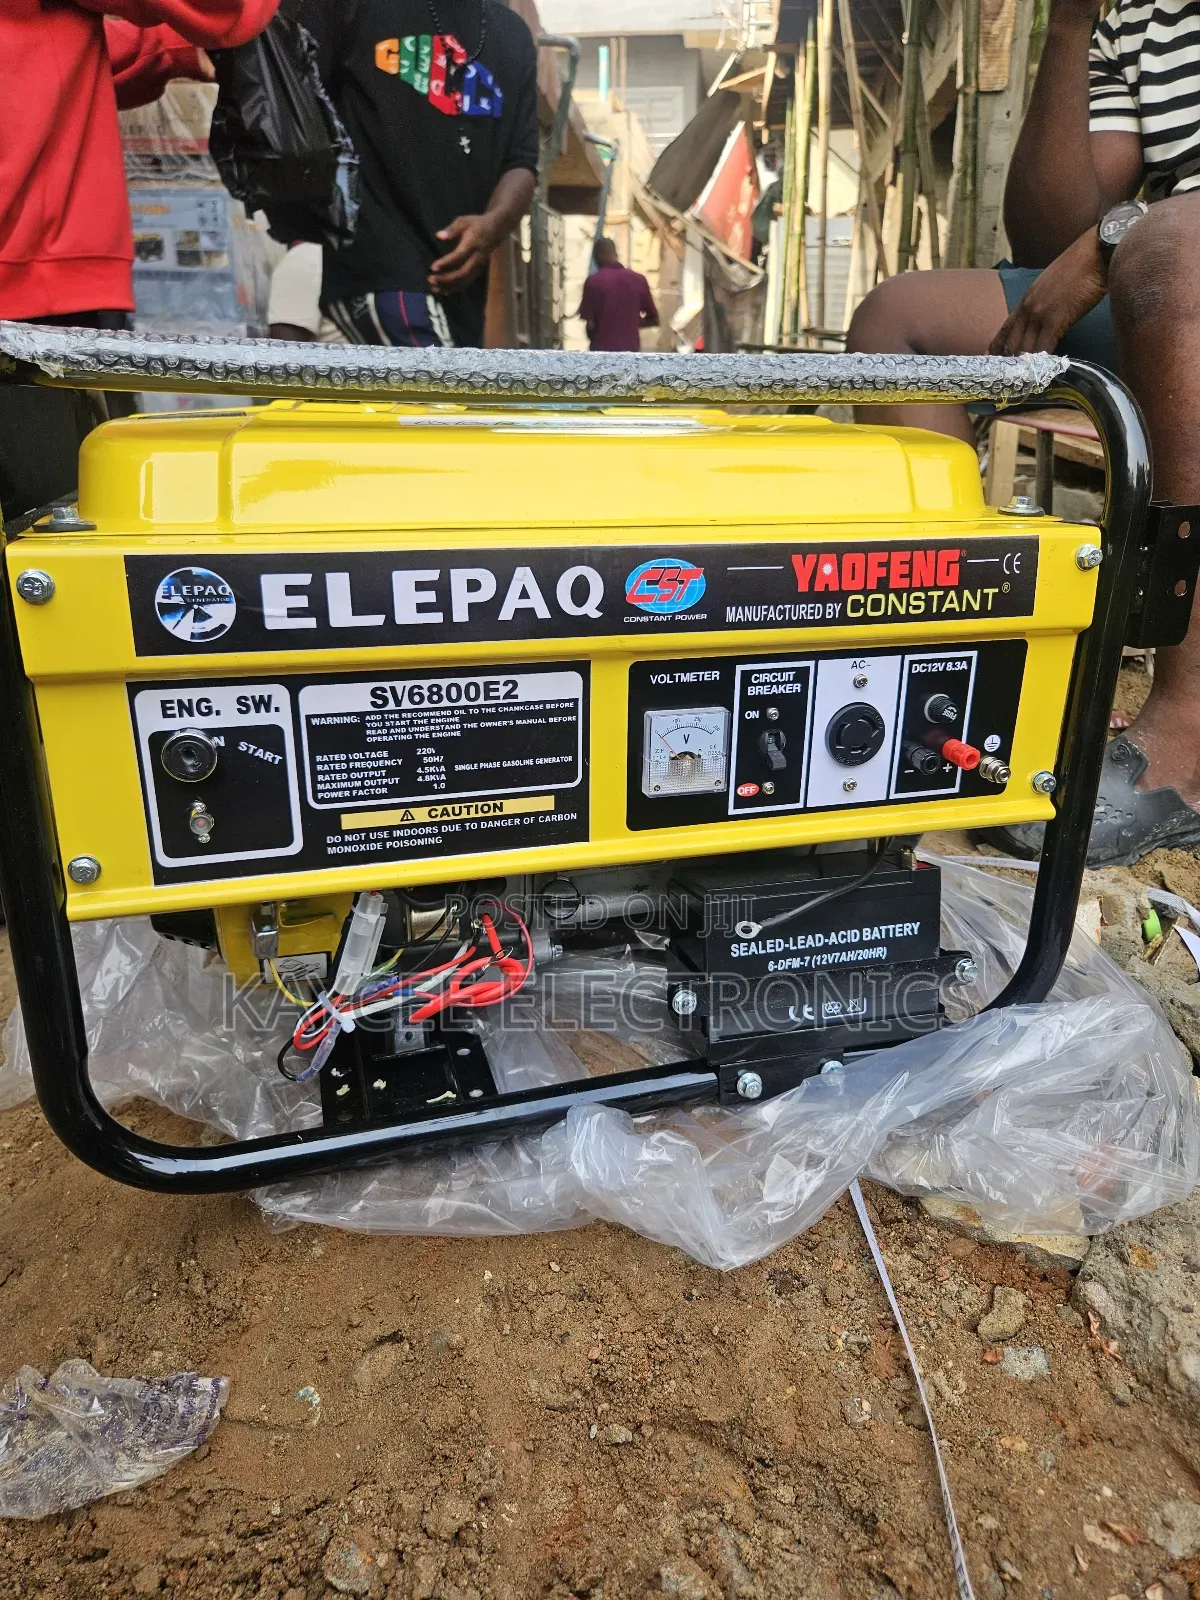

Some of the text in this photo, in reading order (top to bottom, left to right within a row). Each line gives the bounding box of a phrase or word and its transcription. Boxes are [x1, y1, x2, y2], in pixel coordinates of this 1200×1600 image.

[792, 549, 960, 593] YAOFENG
[161, 585, 232, 596] ELEPAQ
[626, 566, 704, 604] CST
[261, 565, 604, 630] ELEPAQ
[726, 588, 998, 623] MANUFACTURED BY CONSTANT
[623, 613, 708, 623] CONSTANT POWER
[912, 660, 968, 673] DC12V 8.3A
[650, 671, 720, 685] VOLTMETER
[751, 671, 796, 683] CIRCUIT
[370, 679, 519, 709] SV6800E2
[747, 683, 801, 696] BREAKER
[160, 694, 280, 719] ENG. SW.
[311, 715, 360, 725] WARNING:
[405, 710, 451, 718] RECOMMEND
[745, 711, 759, 719] ON
[366, 728, 387, 736] READ
[408, 724, 460, 733] UNDERSTAND
[480, 720, 514, 728] OWNER'S
[516, 718, 546, 726] MANUAL
[367, 734, 412, 743] OPERATING
[414, 732, 430, 740] THE
[683, 734, 690, 744] V
[237, 741, 282, 765] START
[316, 751, 389, 762] RATED VOLTAGE
[317, 759, 403, 771] RATED FREQUENCY
[423, 756, 444, 764] 50HZ
[502, 759, 534, 767] GASOLINE
[535, 756, 573, 765] GENERATOR
[317, 770, 387, 782] RATED OUTPUT
[317, 778, 400, 790] MAXIMUM OUTPUT
[318, 788, 388, 799] POWER FACTOR
[738, 786, 756, 796] OFF
[428, 802, 504, 818] CAUTION
[344, 833, 366, 842] NOT
[369, 831, 390, 840] USE
[393, 826, 438, 838] INDOORS
[441, 824, 462, 832] DUE
[464, 822, 478, 830] TO
[481, 818, 520, 829] DANGER
[523, 816, 536, 824] OF
[538, 813, 577, 823] CARBON
[327, 837, 443, 855] MONOXIDE POISONING
[730, 922, 921, 957] SEALED-LEAD-ACID BATTERY
[768, 947, 888, 972] 6-DFM-7 (12V7AH/20HR)
